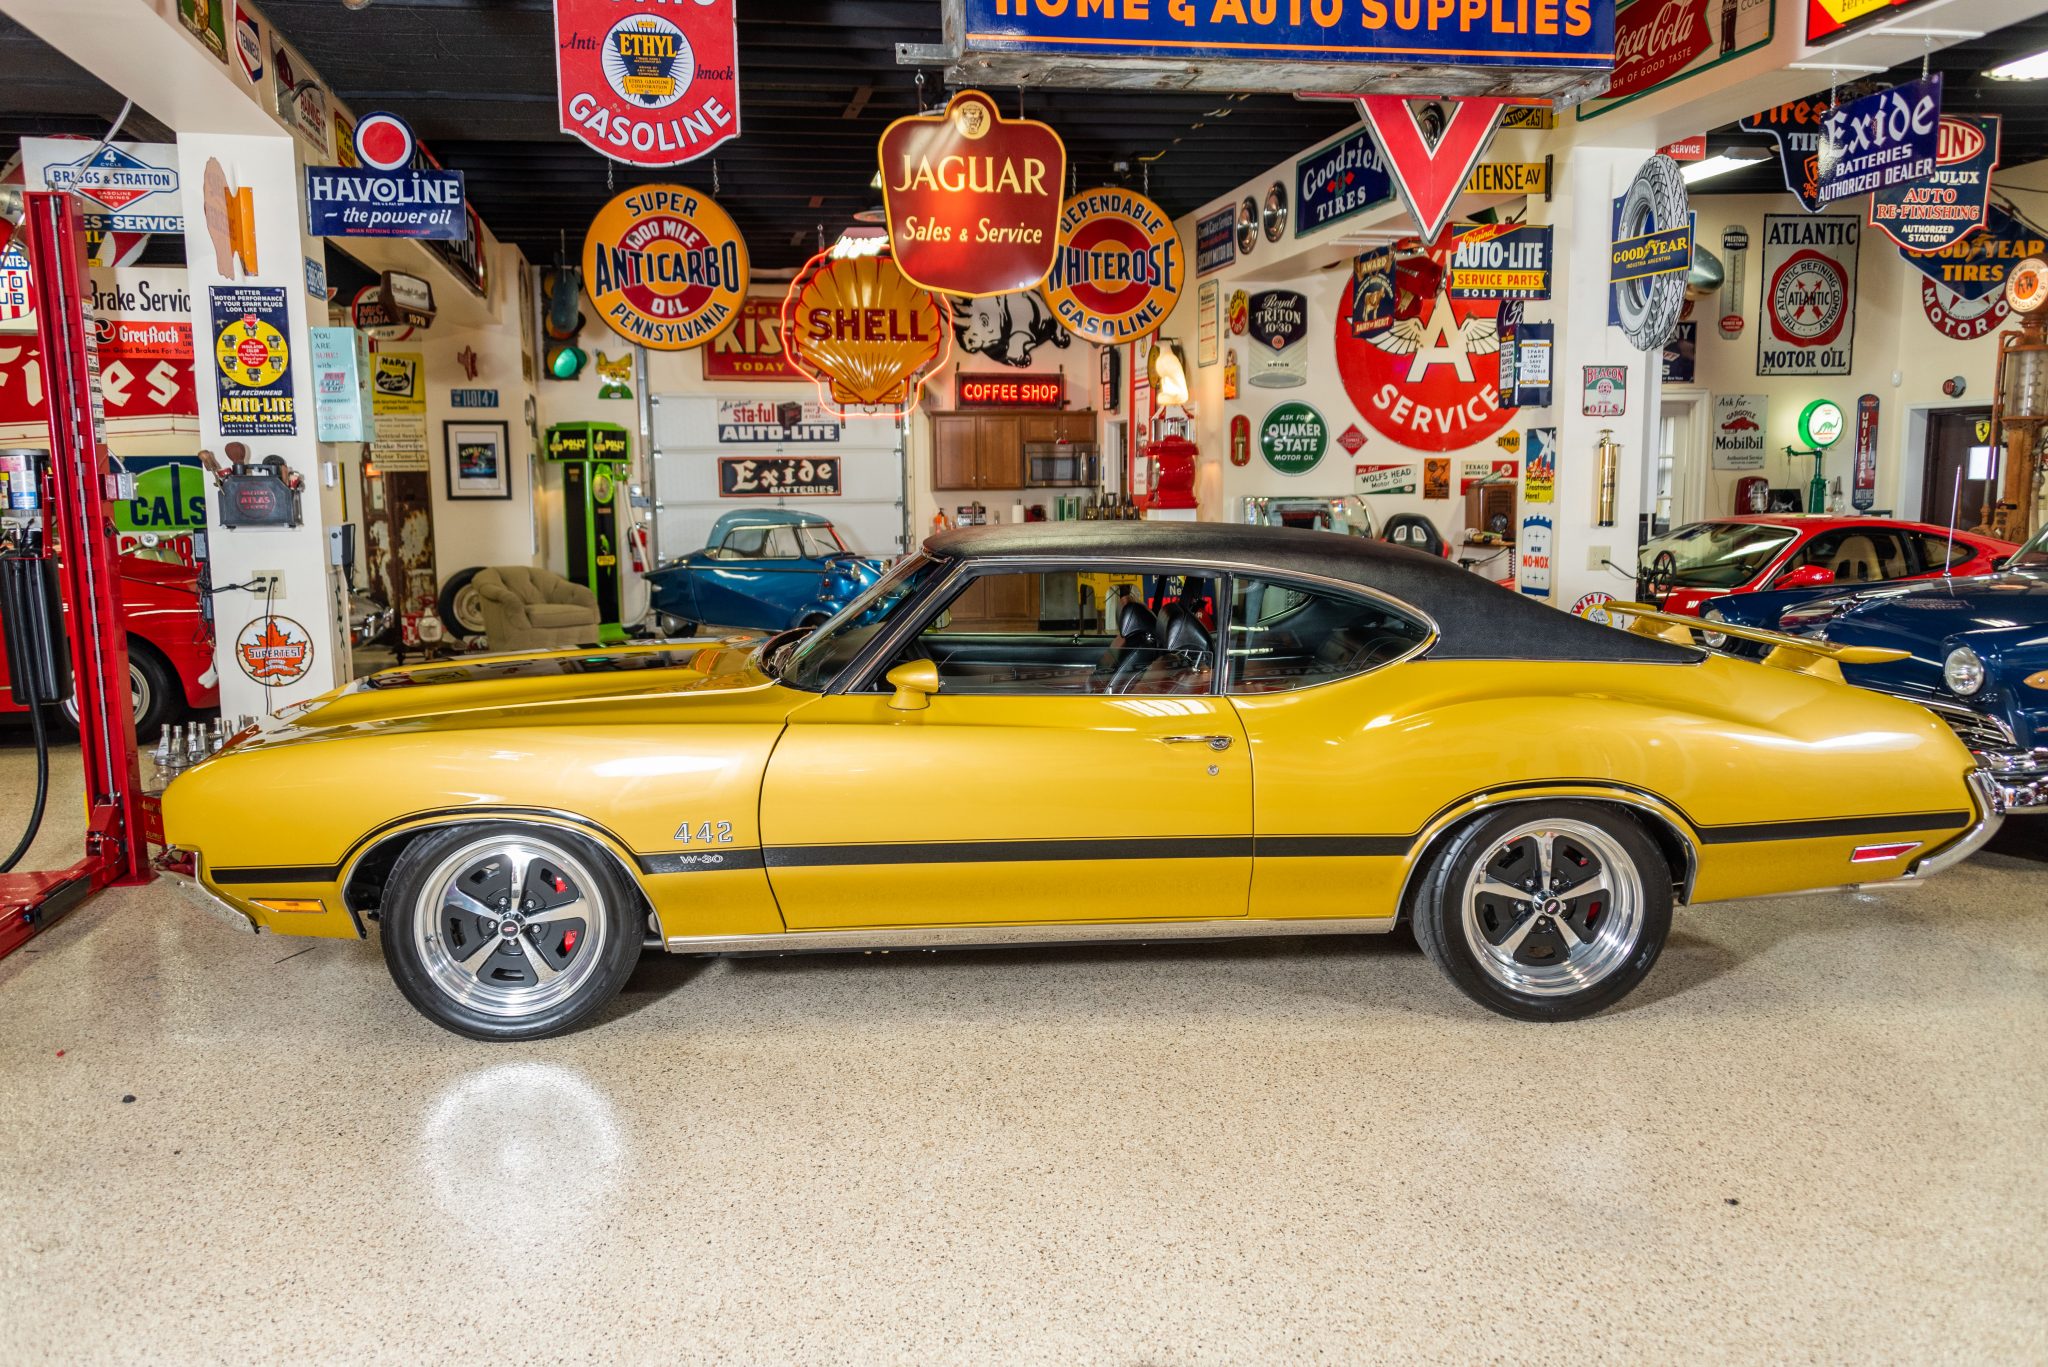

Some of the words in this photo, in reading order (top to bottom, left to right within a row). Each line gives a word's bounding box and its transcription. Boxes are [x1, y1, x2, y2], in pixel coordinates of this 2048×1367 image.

[1361, 0, 1592, 36] SUPPLIES
[619, 33, 677, 57] ETHYL
[696, 64, 734, 81] knock
[1628, 72, 1638, 83] OF
[1641, 61, 1665, 77] GOOD
[1669, 47, 1692, 64] TASTE
[568, 92, 732, 151] GASOLINE
[1525, 109, 1541, 126] GAS
[1823, 91, 1935, 159] Exide
[103, 150, 117, 163] 4
[1670, 144, 1701, 155] SERVICE
[1836, 143, 1913, 177] BATTERIES
[893, 155, 1049, 196] JAGUAR
[1302, 137, 1384, 201] Goodrich
[1525, 169, 1541, 185] AV
[53, 170, 100, 184] BRIGGS
[103, 176, 110, 184] &
[113, 172, 170, 186] STRATTON
[1818, 171, 1880, 202] AUTHORIZED
[1885, 158, 1933, 185] DEALER
[311, 172, 461, 205] HAVOLINE
[1903, 188, 1957, 204] AUTO
[625, 191, 699, 218] SUPER
[1316, 186, 1367, 222] TIRES
[1876, 203, 1980, 220] RE-FINISHING
[343, 207, 369, 223] the
[368, 209, 426, 228] power
[429, 209, 452, 225] oil
[1060, 195, 1164, 234] DEPENDABLE
[663, 220, 700, 248] MILE
[903, 216, 951, 242] Sales
[960, 228, 968, 242] &
[976, 218, 1042, 244] Service
[1463, 225, 1497, 249] Original
[1768, 222, 1857, 246] ATLANTIC
[1901, 224, 1955, 233] AUTHORIZED
[1908, 234, 1946, 242] STATION
[1454, 242, 1543, 269] AUTO-LITE
[595, 240, 740, 297] ANTICARBO
[1048, 237, 1177, 294] WHITEROSE
[1362, 256, 1387, 273] AWARD
[1941, 264, 2004, 281] TIRES
[1457, 273, 1502, 286] SERVICE
[1507, 274, 1540, 286] PARTS
[1801, 262, 1838, 288] REFINING
[1464, 289, 1497, 298] SOLD
[1503, 290, 1535, 298] HERE
[1777, 267, 1799, 310] ATLANTIC
[651, 298, 689, 315] OIL
[1261, 293, 1296, 310] Royal
[1788, 291, 1830, 305] ATLANTIC
[744, 306, 778, 314] GET
[1058, 298, 1164, 337] GASOLINE
[1255, 308, 1302, 327] TRITON
[1820, 290, 1840, 331] COMPANY
[1924, 287, 1988, 338] MOTOR
[610, 302, 730, 342] PENNSYLVANIA
[808, 308, 929, 342] SHELL
[1781, 313, 1797, 331] THE
[119, 325, 178, 346] Grey-Rock
[381, 357, 407, 367] NAPA
[733, 361, 785, 371] TODAY
[1763, 350, 1816, 368] MOTOR
[1820, 350, 1847, 368] OIL
[1587, 368, 1624, 384] BEACON
[964, 384, 1018, 400] COFFEE
[1022, 384, 1059, 400] SHOP
[221, 397, 293, 413] AUTO-LITE
[1372, 383, 1500, 434] SERVICE
[1718, 398, 1734, 406] Ask
[222, 414, 258, 422] SPARK
[259, 414, 293, 423] PLUGS
[1726, 409, 1757, 420] GARGOYLE
[722, 425, 835, 440] AUTO-LITE
[1268, 423, 1321, 438] QUAKER
[1273, 438, 1318, 452] STATE
[1715, 436, 1763, 450] Mobiloil
[1858, 412, 1869, 487] UNIVERSAL
[731, 459, 832, 492] Exide
[1391, 468, 1412, 478] HEAD
[769, 485, 835, 494] BATTERIES
[240, 496, 271, 504] ATLAS
[1523, 554, 1549, 569] NO-NOX
[249, 647, 301, 658] SUPERTEST
[674, 820, 733, 843] 442
[680, 854, 724, 864] W-30
